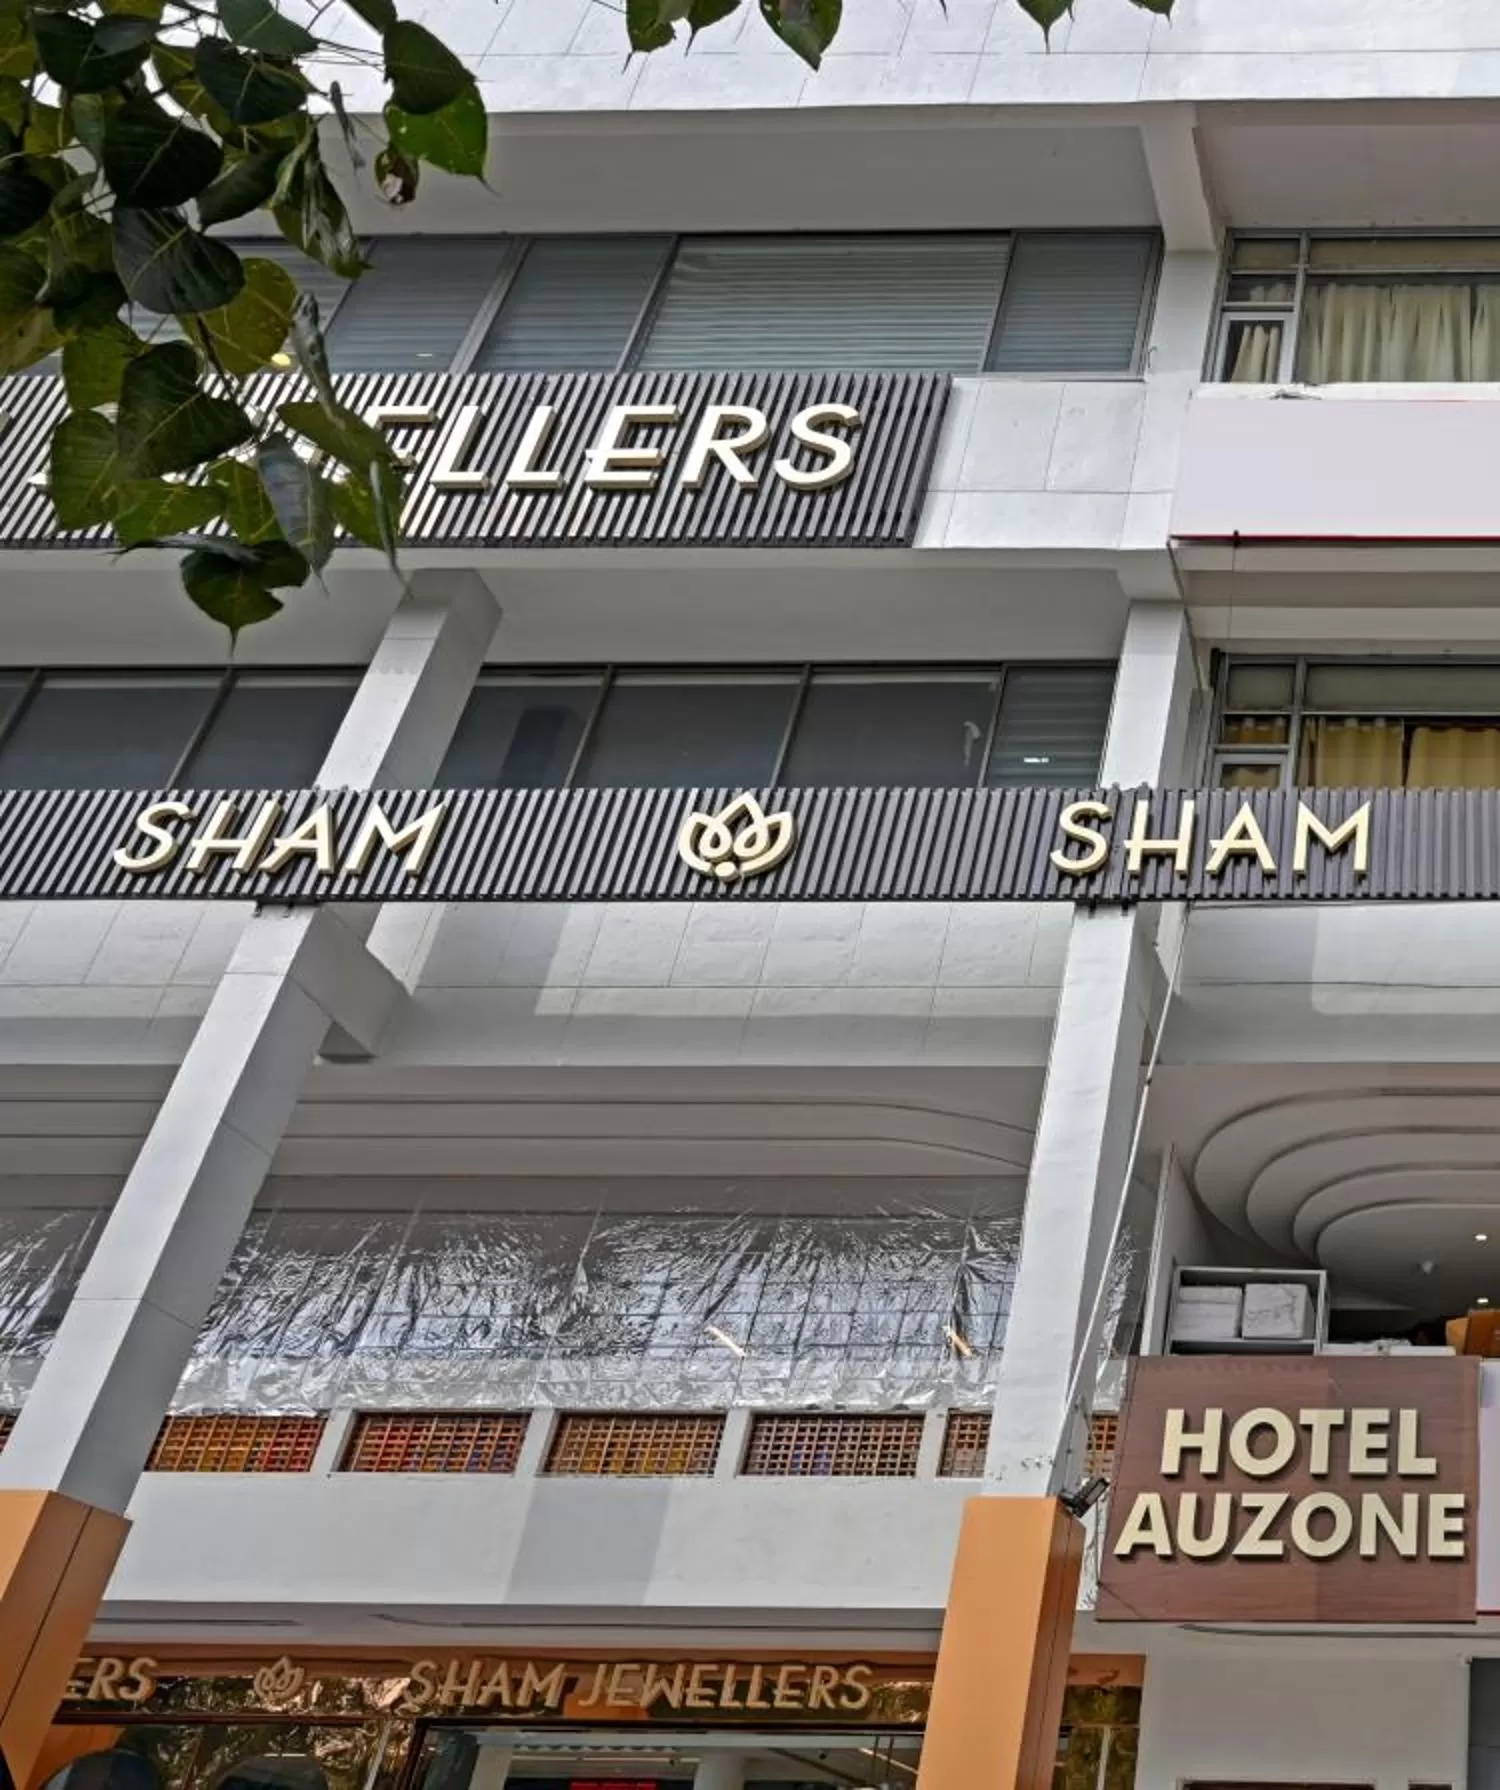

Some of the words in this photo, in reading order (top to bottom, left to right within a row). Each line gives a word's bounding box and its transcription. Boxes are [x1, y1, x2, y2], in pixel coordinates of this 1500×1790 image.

[112, 799, 447, 879] SHAM
[1049, 799, 1372, 878] SHAM
[1159, 1407, 1438, 1477] HOTEL
[1113, 1492, 1467, 1560] AUZONE
[402, 1658, 568, 1709] SHAM
[577, 1660, 875, 1711] JEWELLERS
